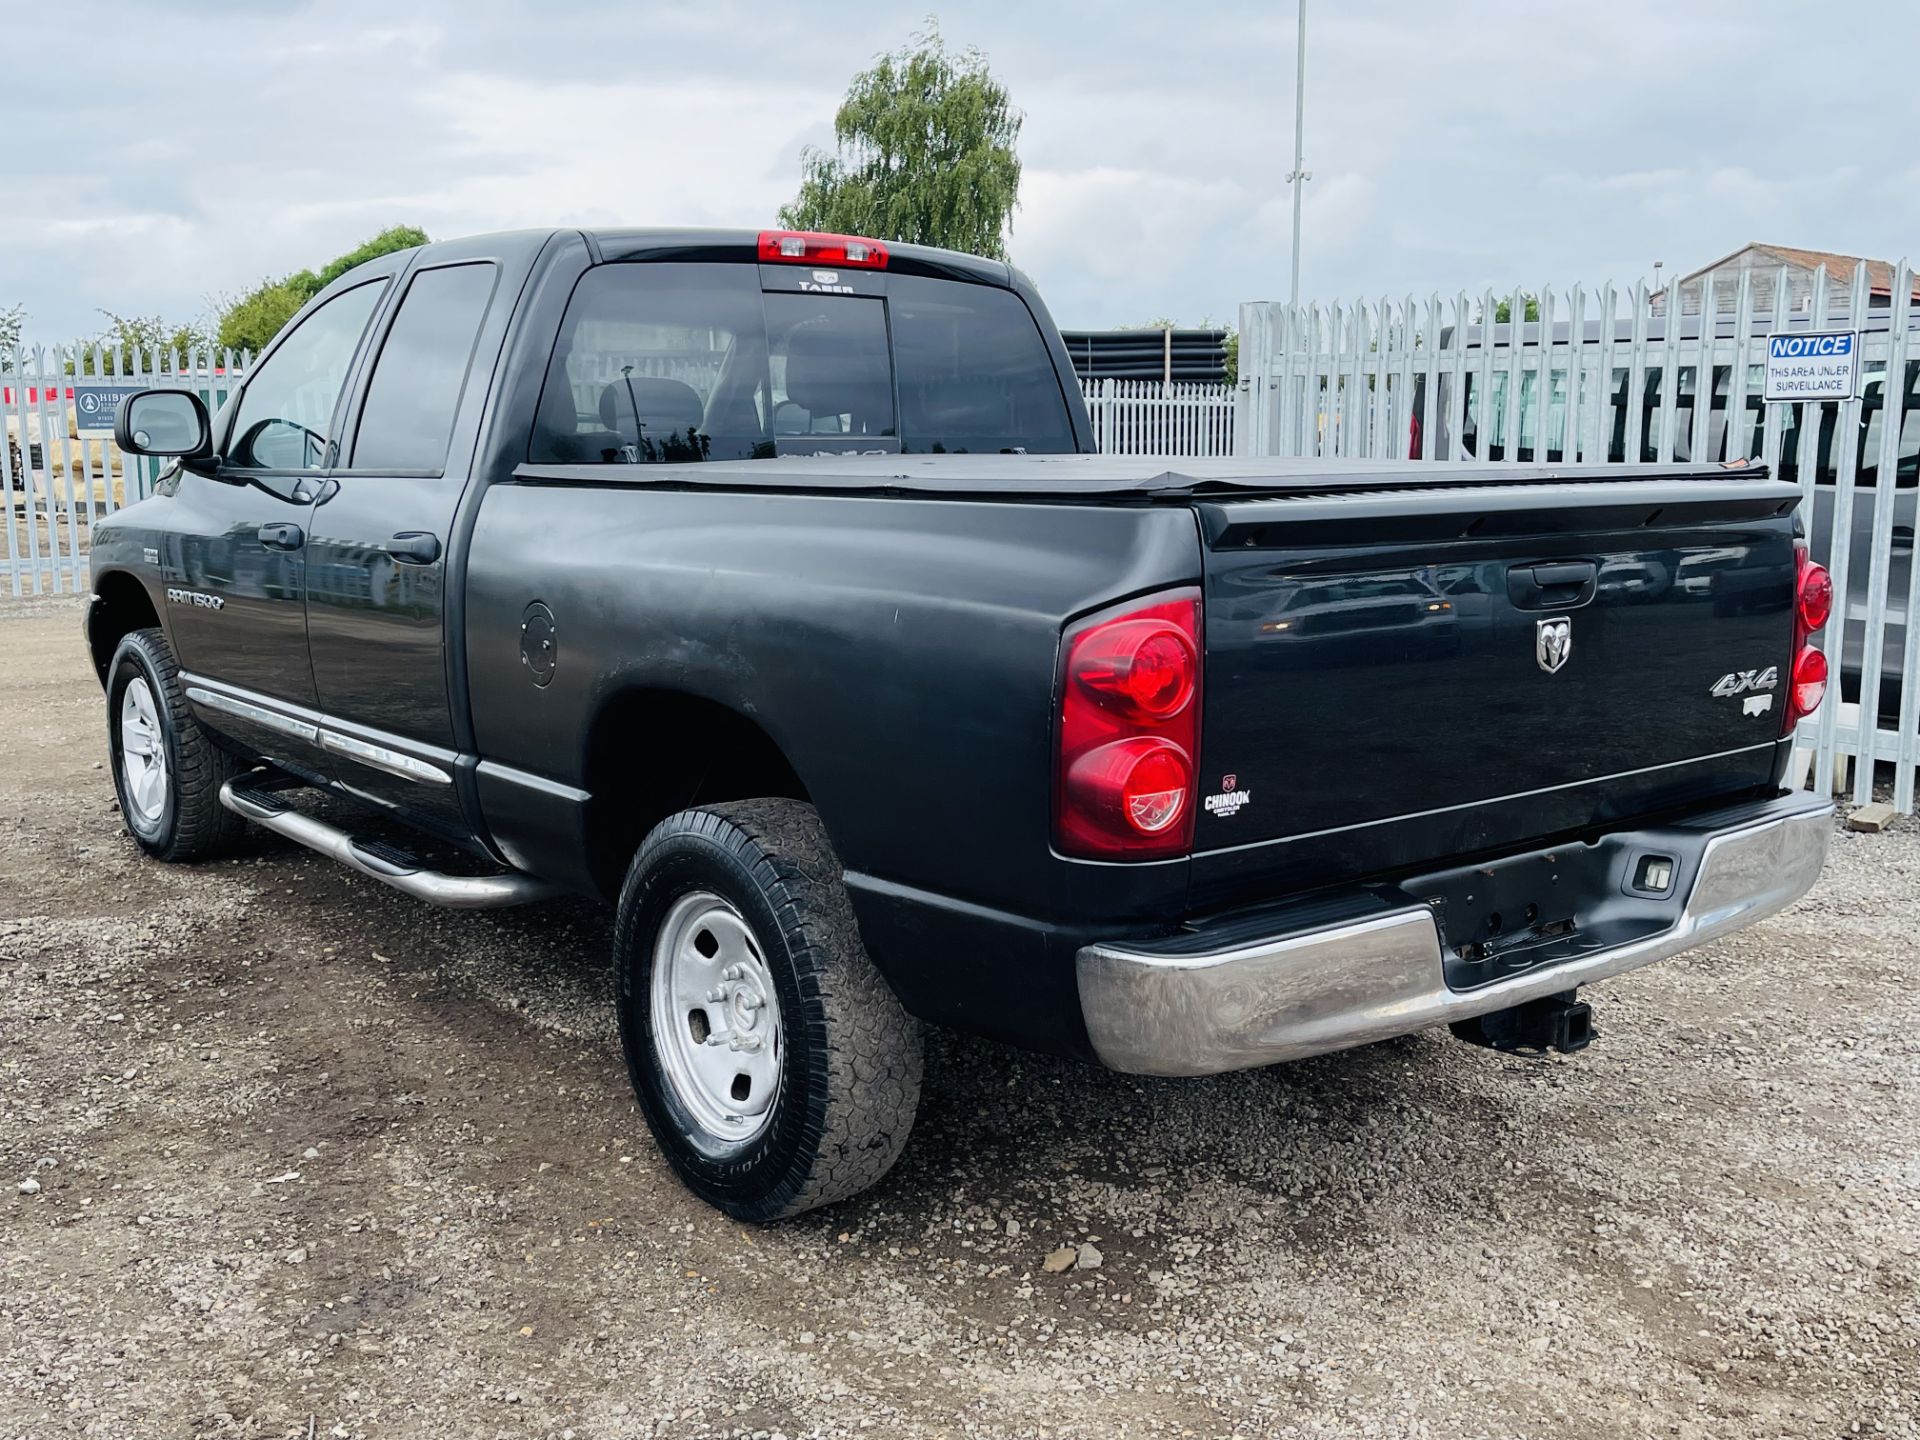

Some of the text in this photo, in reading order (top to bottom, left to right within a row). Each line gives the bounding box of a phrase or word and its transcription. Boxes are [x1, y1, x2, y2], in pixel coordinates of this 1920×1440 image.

[1772, 336, 1849, 357] NOTICE
[1770, 365, 1849, 378] THIS AREA UNDER
[1776, 379, 1843, 392] SURVEILLANCE
[167, 588, 221, 610] RAM 1500
[1204, 789, 1250, 811] CHINOOK
